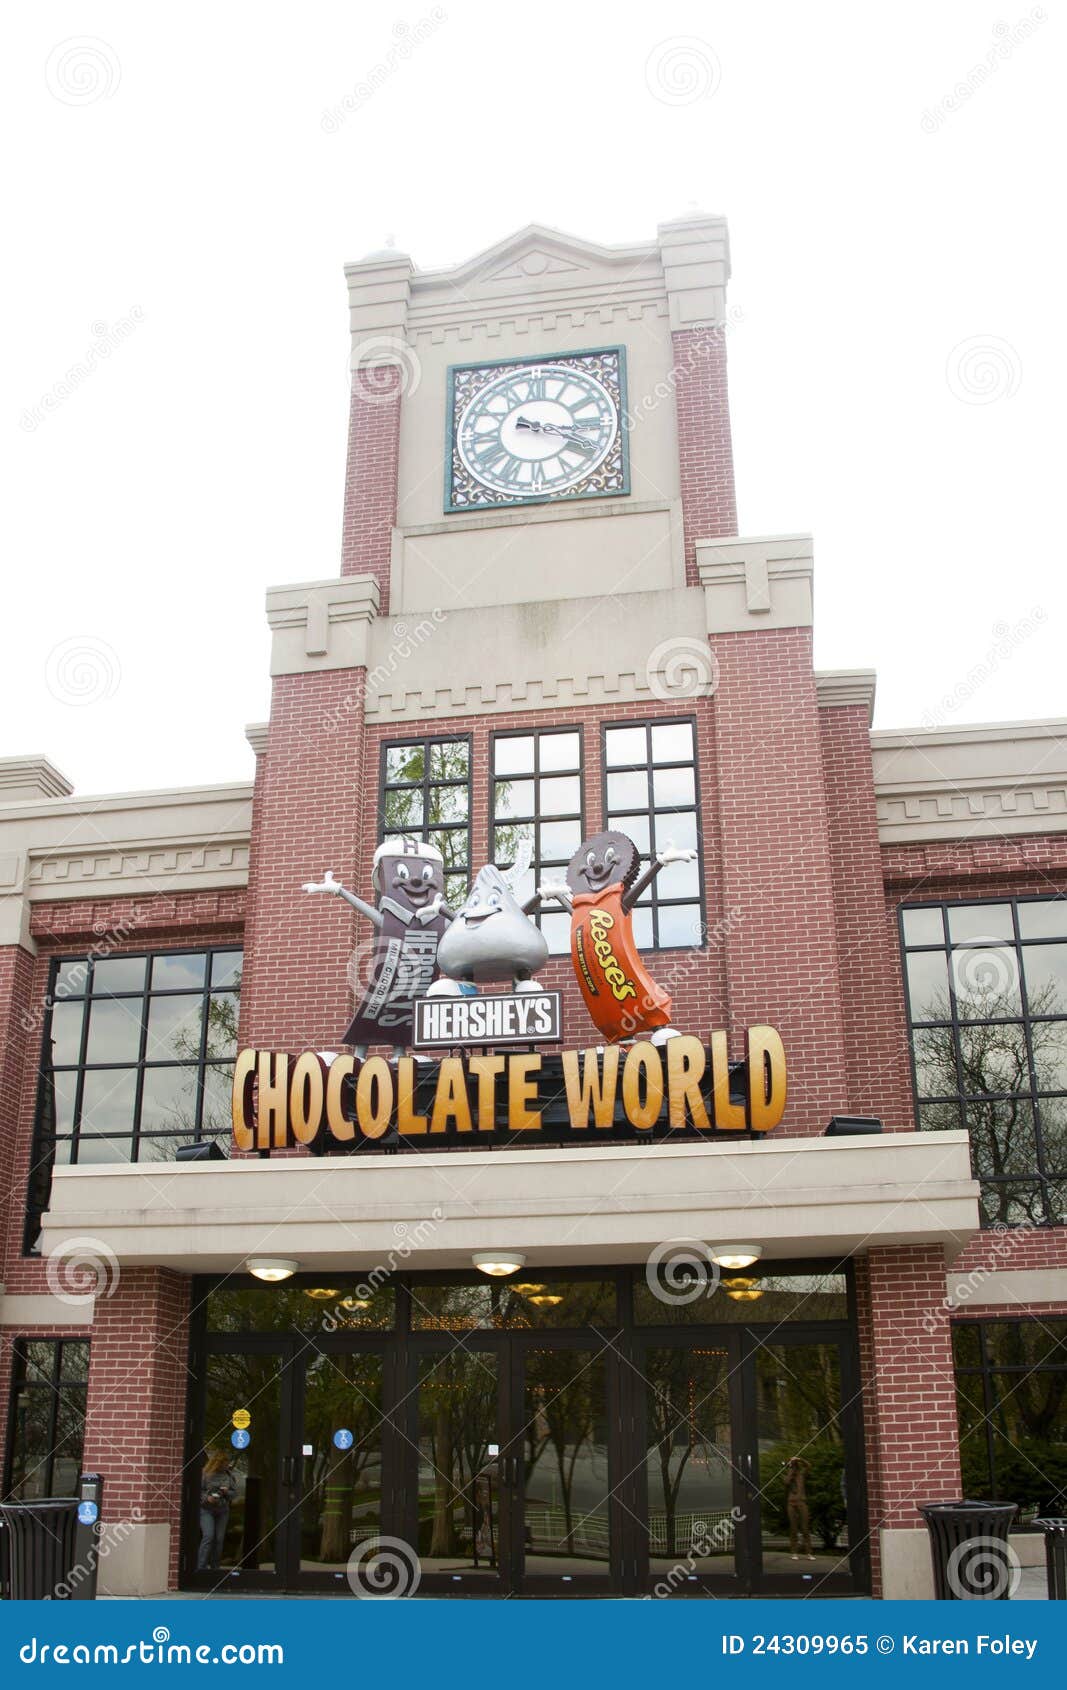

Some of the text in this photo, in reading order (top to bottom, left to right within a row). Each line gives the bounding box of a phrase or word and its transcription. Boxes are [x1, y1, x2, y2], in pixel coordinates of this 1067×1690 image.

[403, 840, 419, 854] H
[368, 966, 392, 1016] CHOCOLATE
[378, 930, 438, 1026] HERSHEYS
[423, 997, 552, 1040] HERSHEY'S
[232, 1025, 787, 1152] CHOCOLATE WORLD
